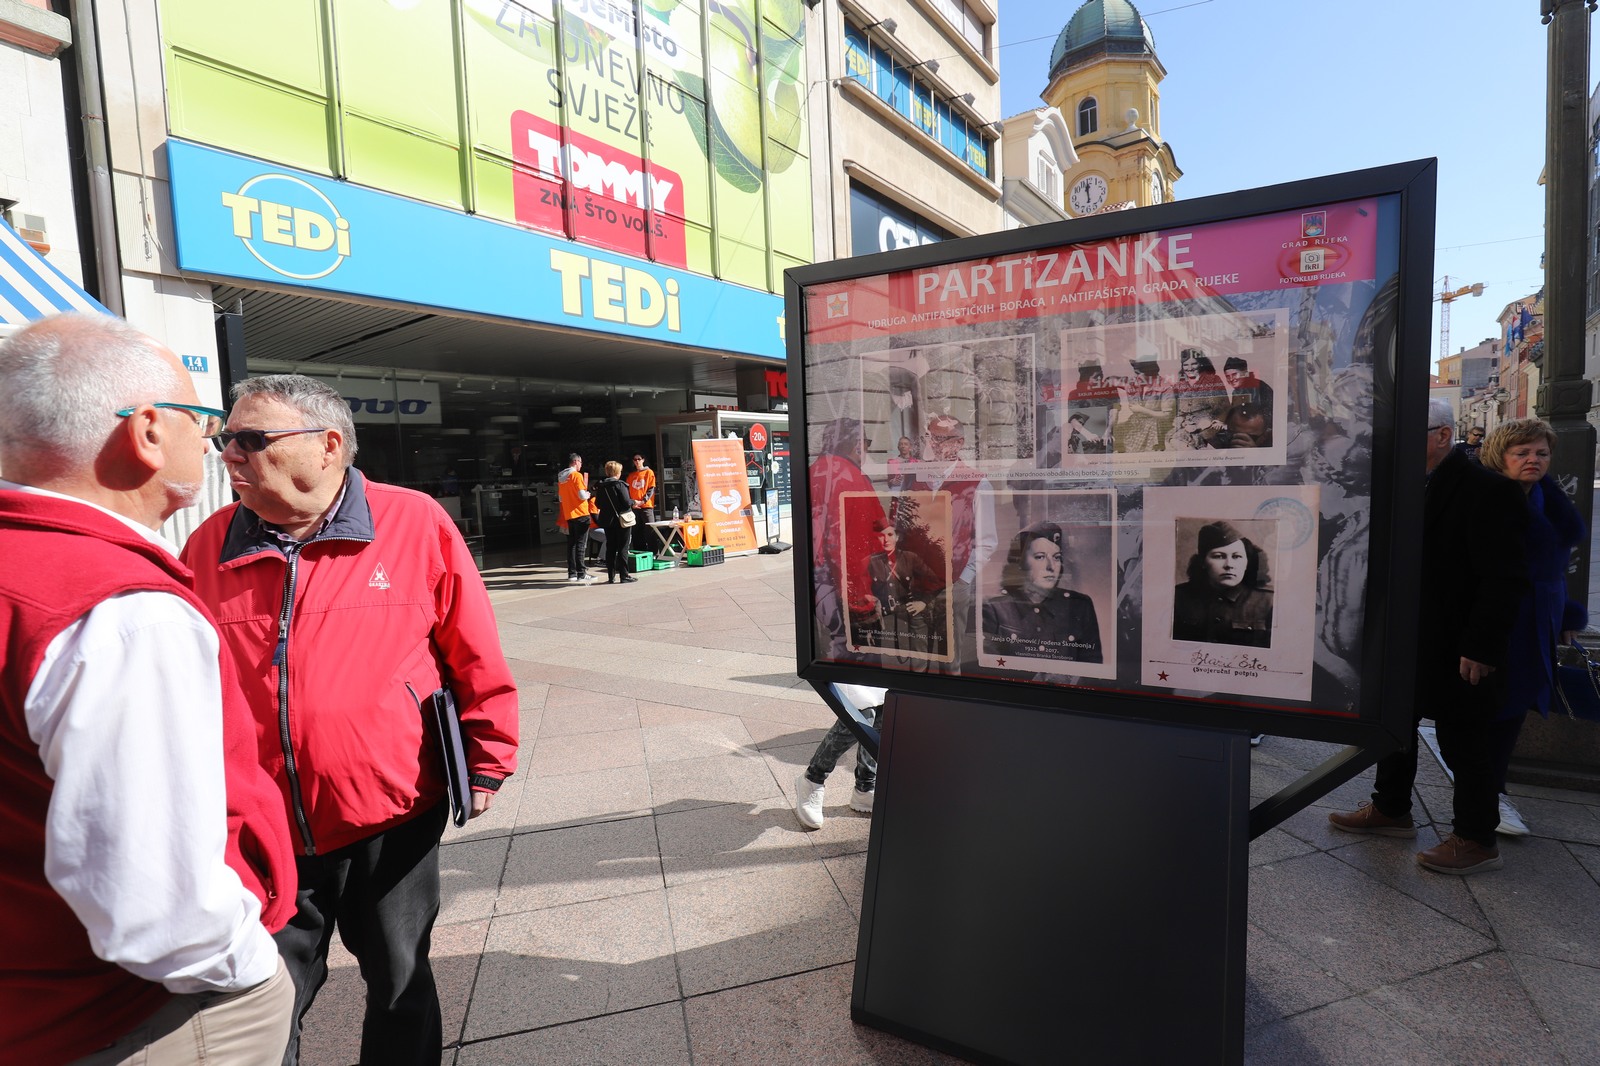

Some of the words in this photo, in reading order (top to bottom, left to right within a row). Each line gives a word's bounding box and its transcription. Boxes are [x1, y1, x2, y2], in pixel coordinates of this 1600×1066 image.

[528, 129, 673, 216] TOMMY
[585, 196, 617, 224] ŠTO
[1282, 240, 1308, 249] GRAD
[1315, 236, 1348, 245] RIJEKA
[1280, 274, 1318, 284] FOTOKLUB
[1320, 271, 1346, 280] RIJEKA
[868, 316, 907, 329] UDRUGA
[911, 304, 995, 323] ANTIFAŠISTIČKIH
[1000, 297, 1046, 312] BORACA
[1060, 286, 1136, 304] ANTIFAŠISTA
[1143, 279, 1188, 293] GRADA
[1195, 273, 1240, 287] RIJEKE
[187, 356, 203, 367] 14
[1100, 469, 1123, 478] Zagreb
